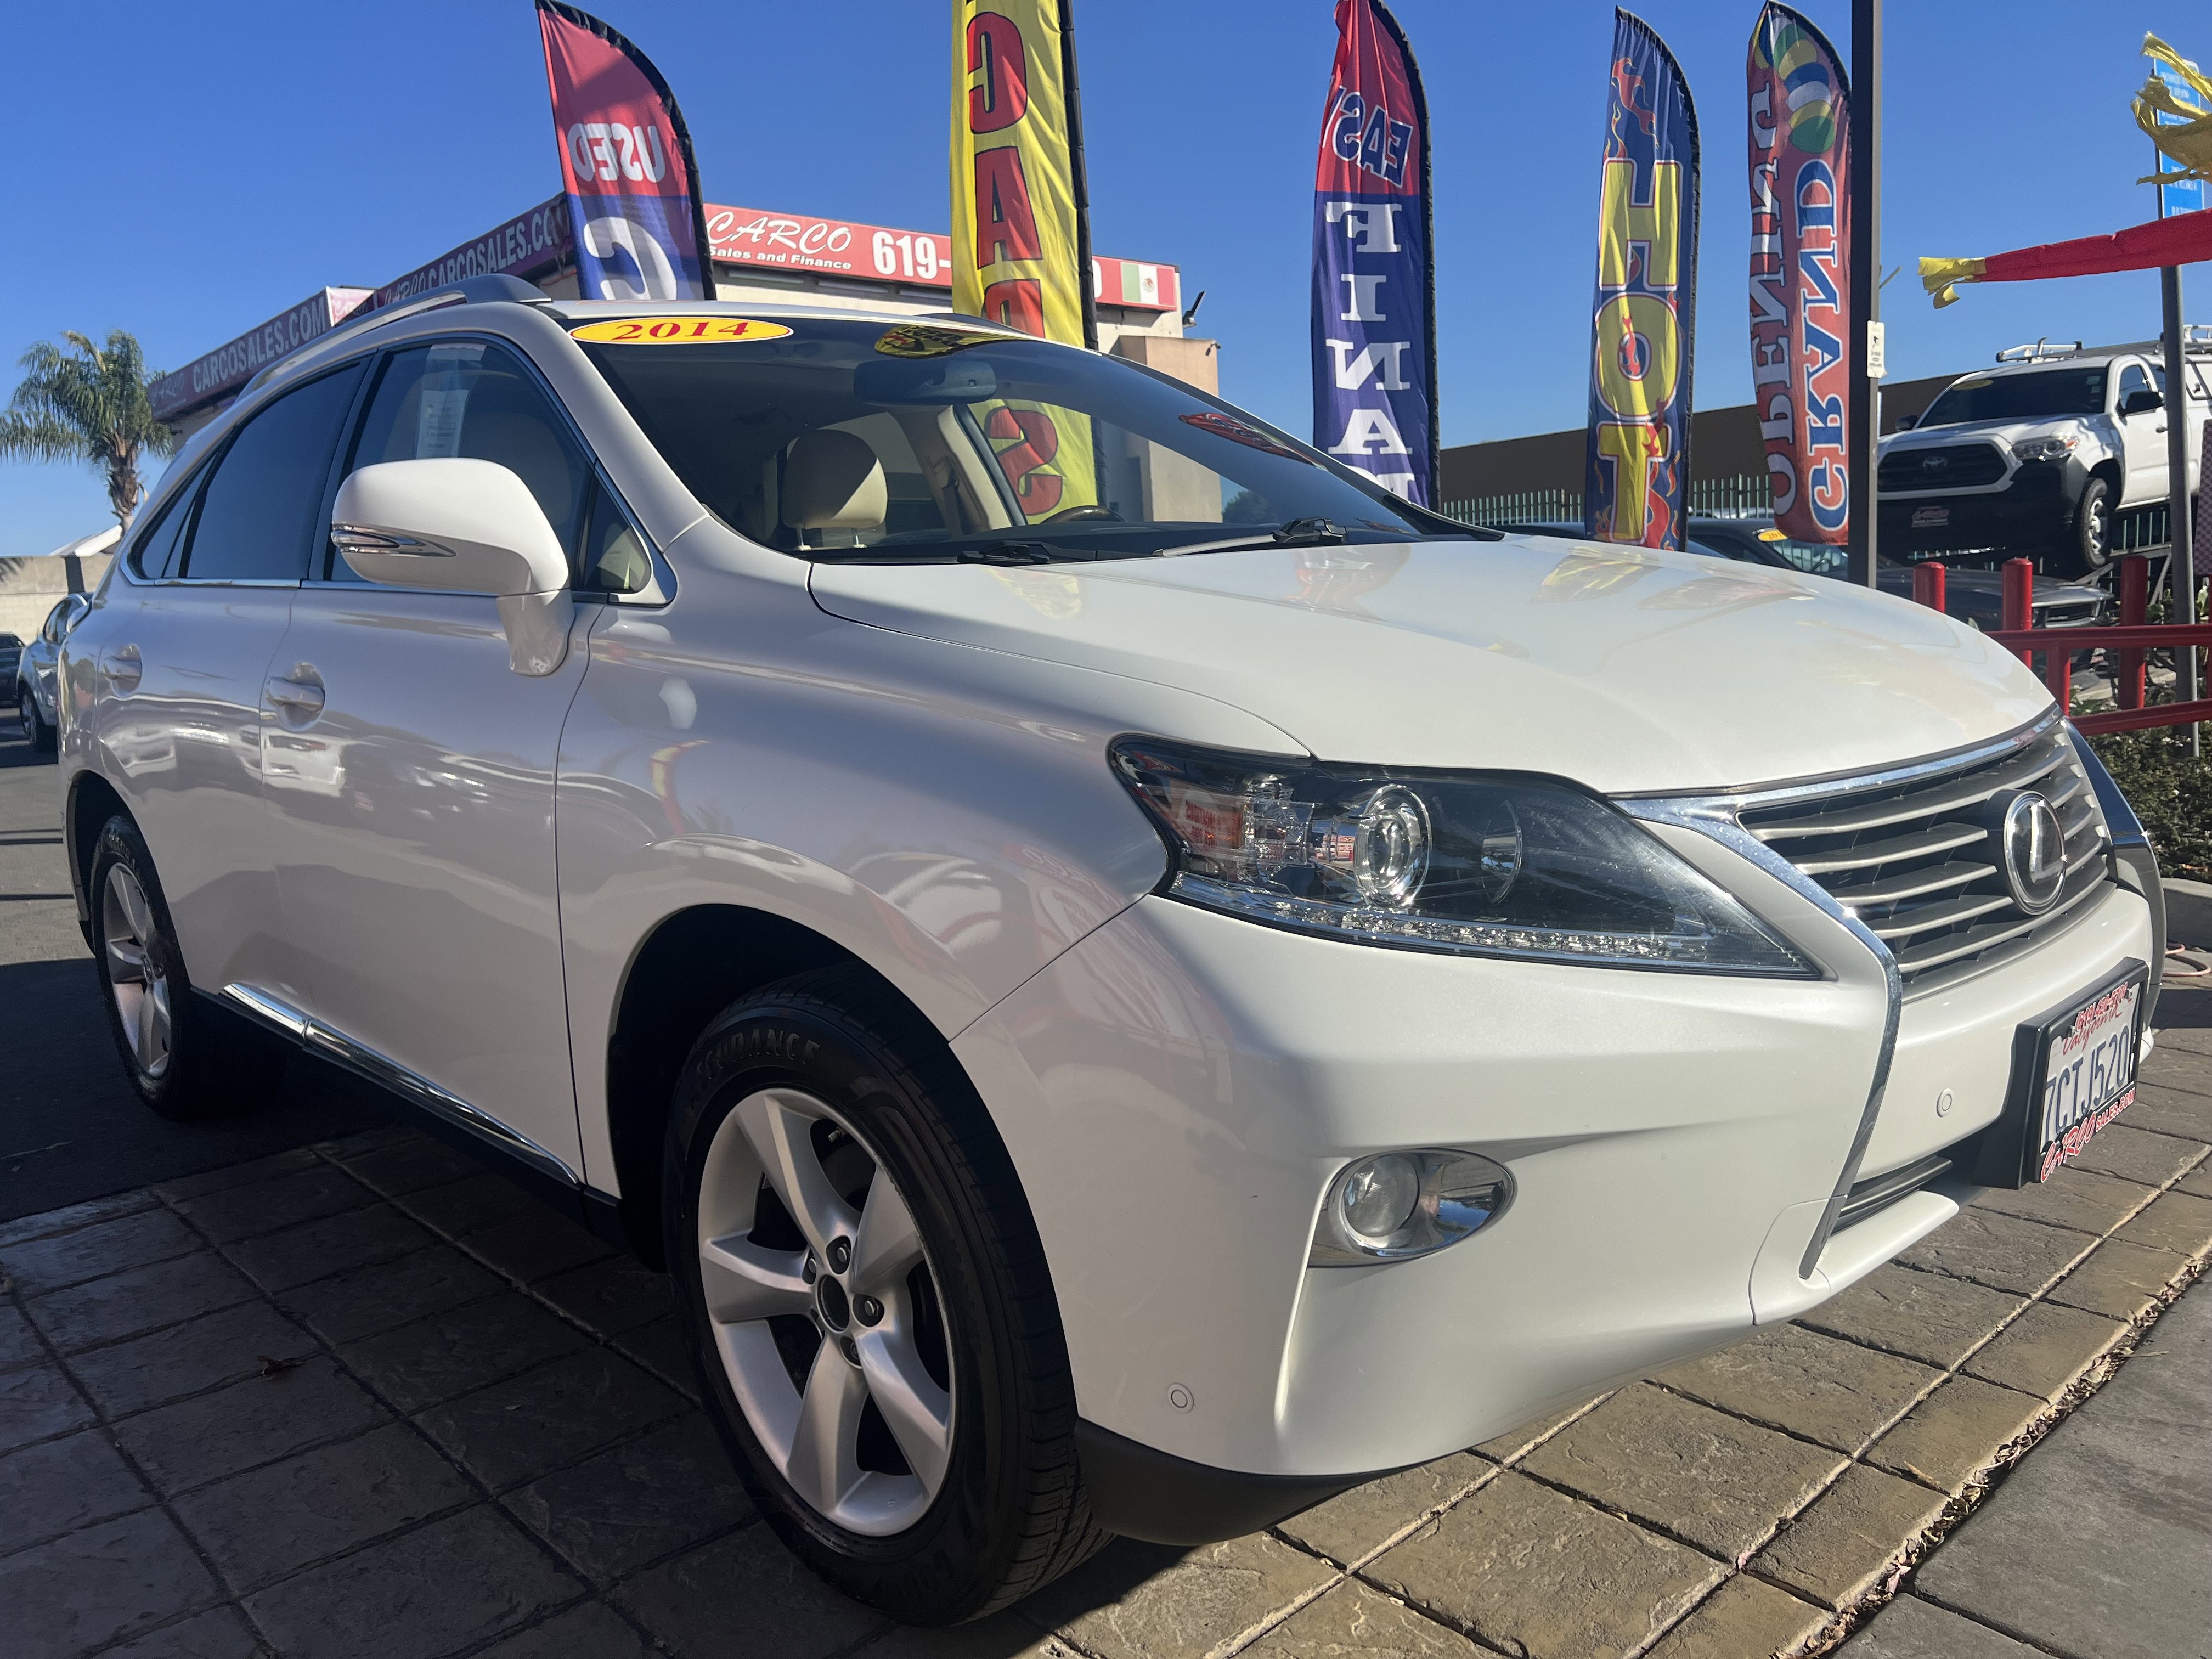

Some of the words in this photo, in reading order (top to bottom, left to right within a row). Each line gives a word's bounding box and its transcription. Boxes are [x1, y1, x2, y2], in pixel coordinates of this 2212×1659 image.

[707, 211, 851, 254] CARCO
[708, 245, 751, 259] Sales
[757, 251, 786, 263] and
[791, 254, 851, 270] Finance
[193, 297, 326, 393] CARCOSALES.COM
[611, 322, 749, 341] 2014
[1593, 157, 1684, 545] HOT
[1768, 531, 1784, 540] 201
[692, 1028, 821, 1091] SSURANCE
[2045, 1025, 2129, 1142] 7CTJ520
[2096, 1087, 2136, 1133] SALES.COM
